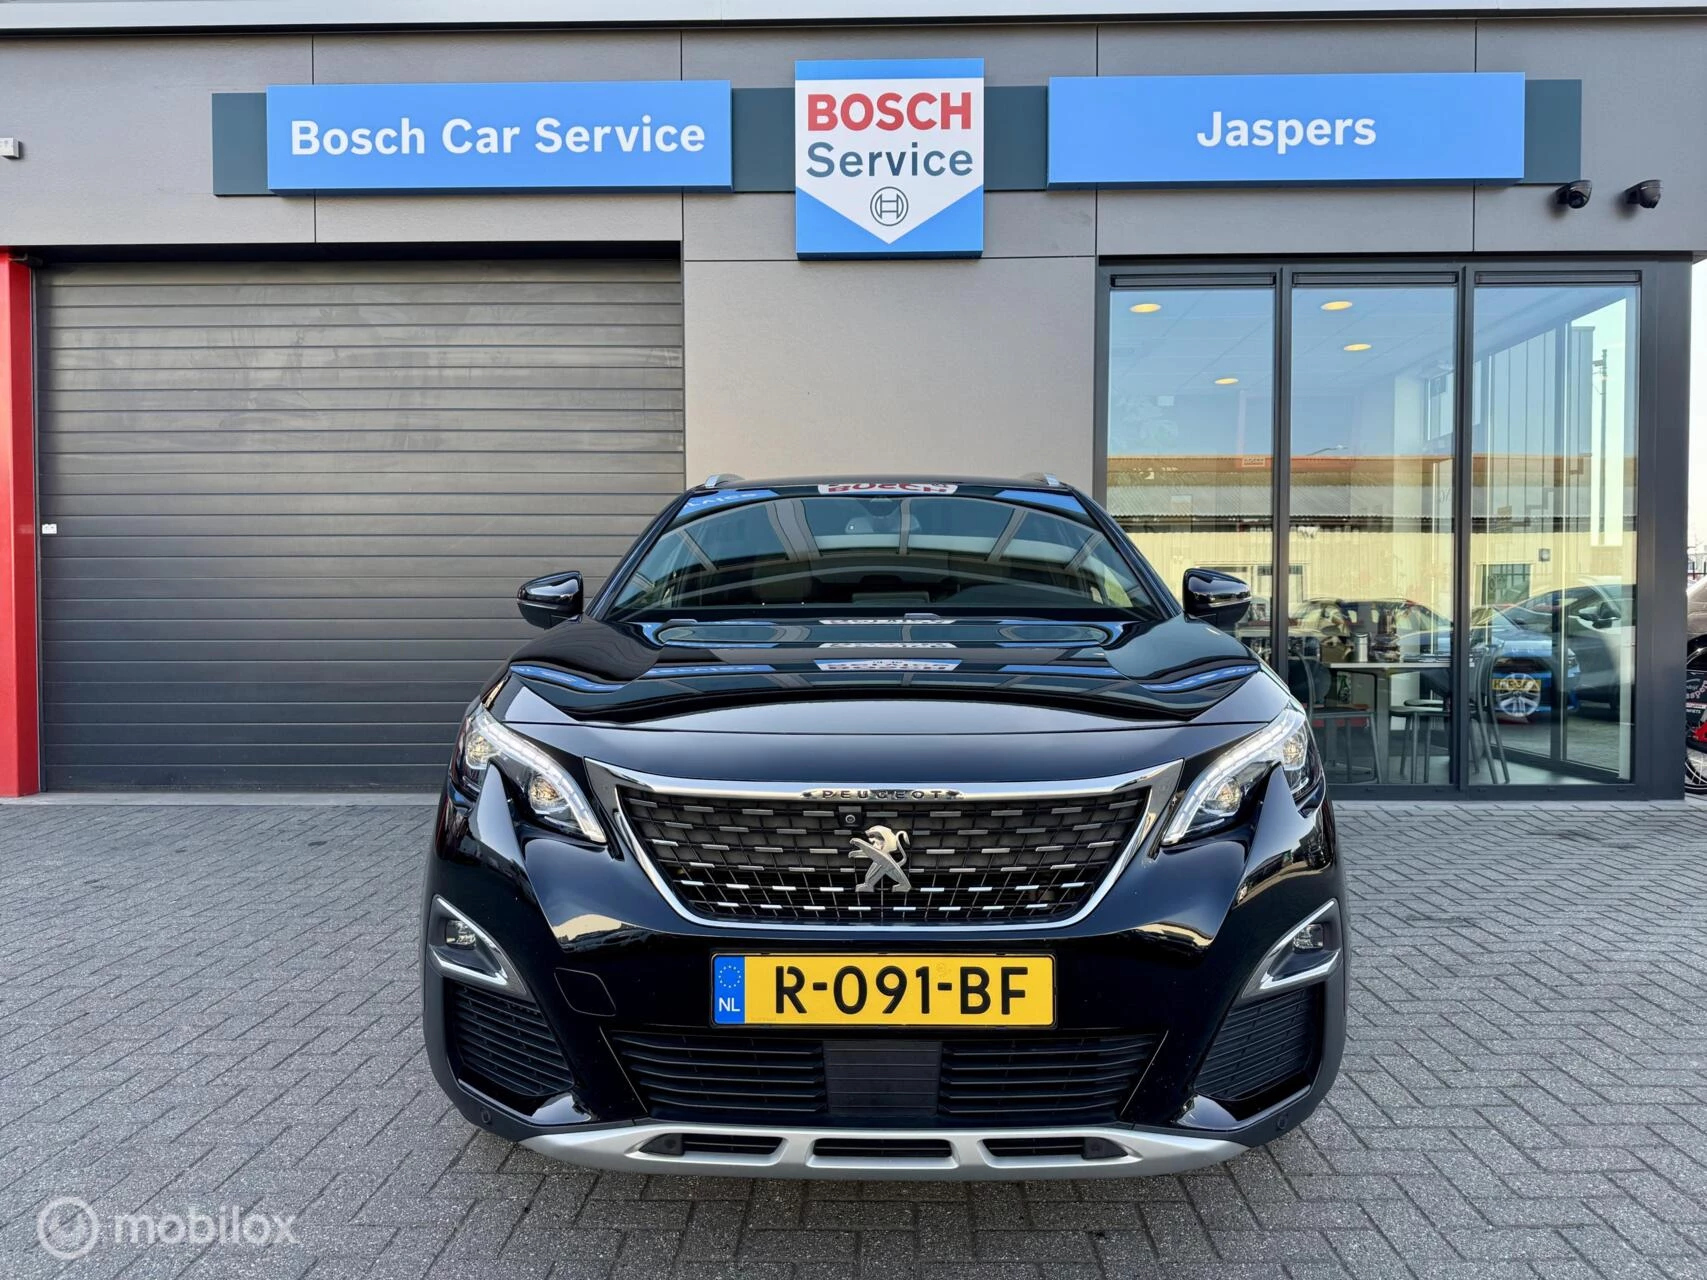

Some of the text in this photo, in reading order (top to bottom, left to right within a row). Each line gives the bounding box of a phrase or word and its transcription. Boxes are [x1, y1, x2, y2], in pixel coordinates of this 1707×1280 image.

[807, 91, 972, 131] BOSCH
[291, 114, 705, 155] Bosch Car Service
[1196, 111, 1377, 154] Jaspers
[806, 141, 973, 178] Service
[821, 790, 943, 799] PEUGEOT
[718, 997, 741, 1012] NL
[775, 966, 1028, 1015] R-091-BF
